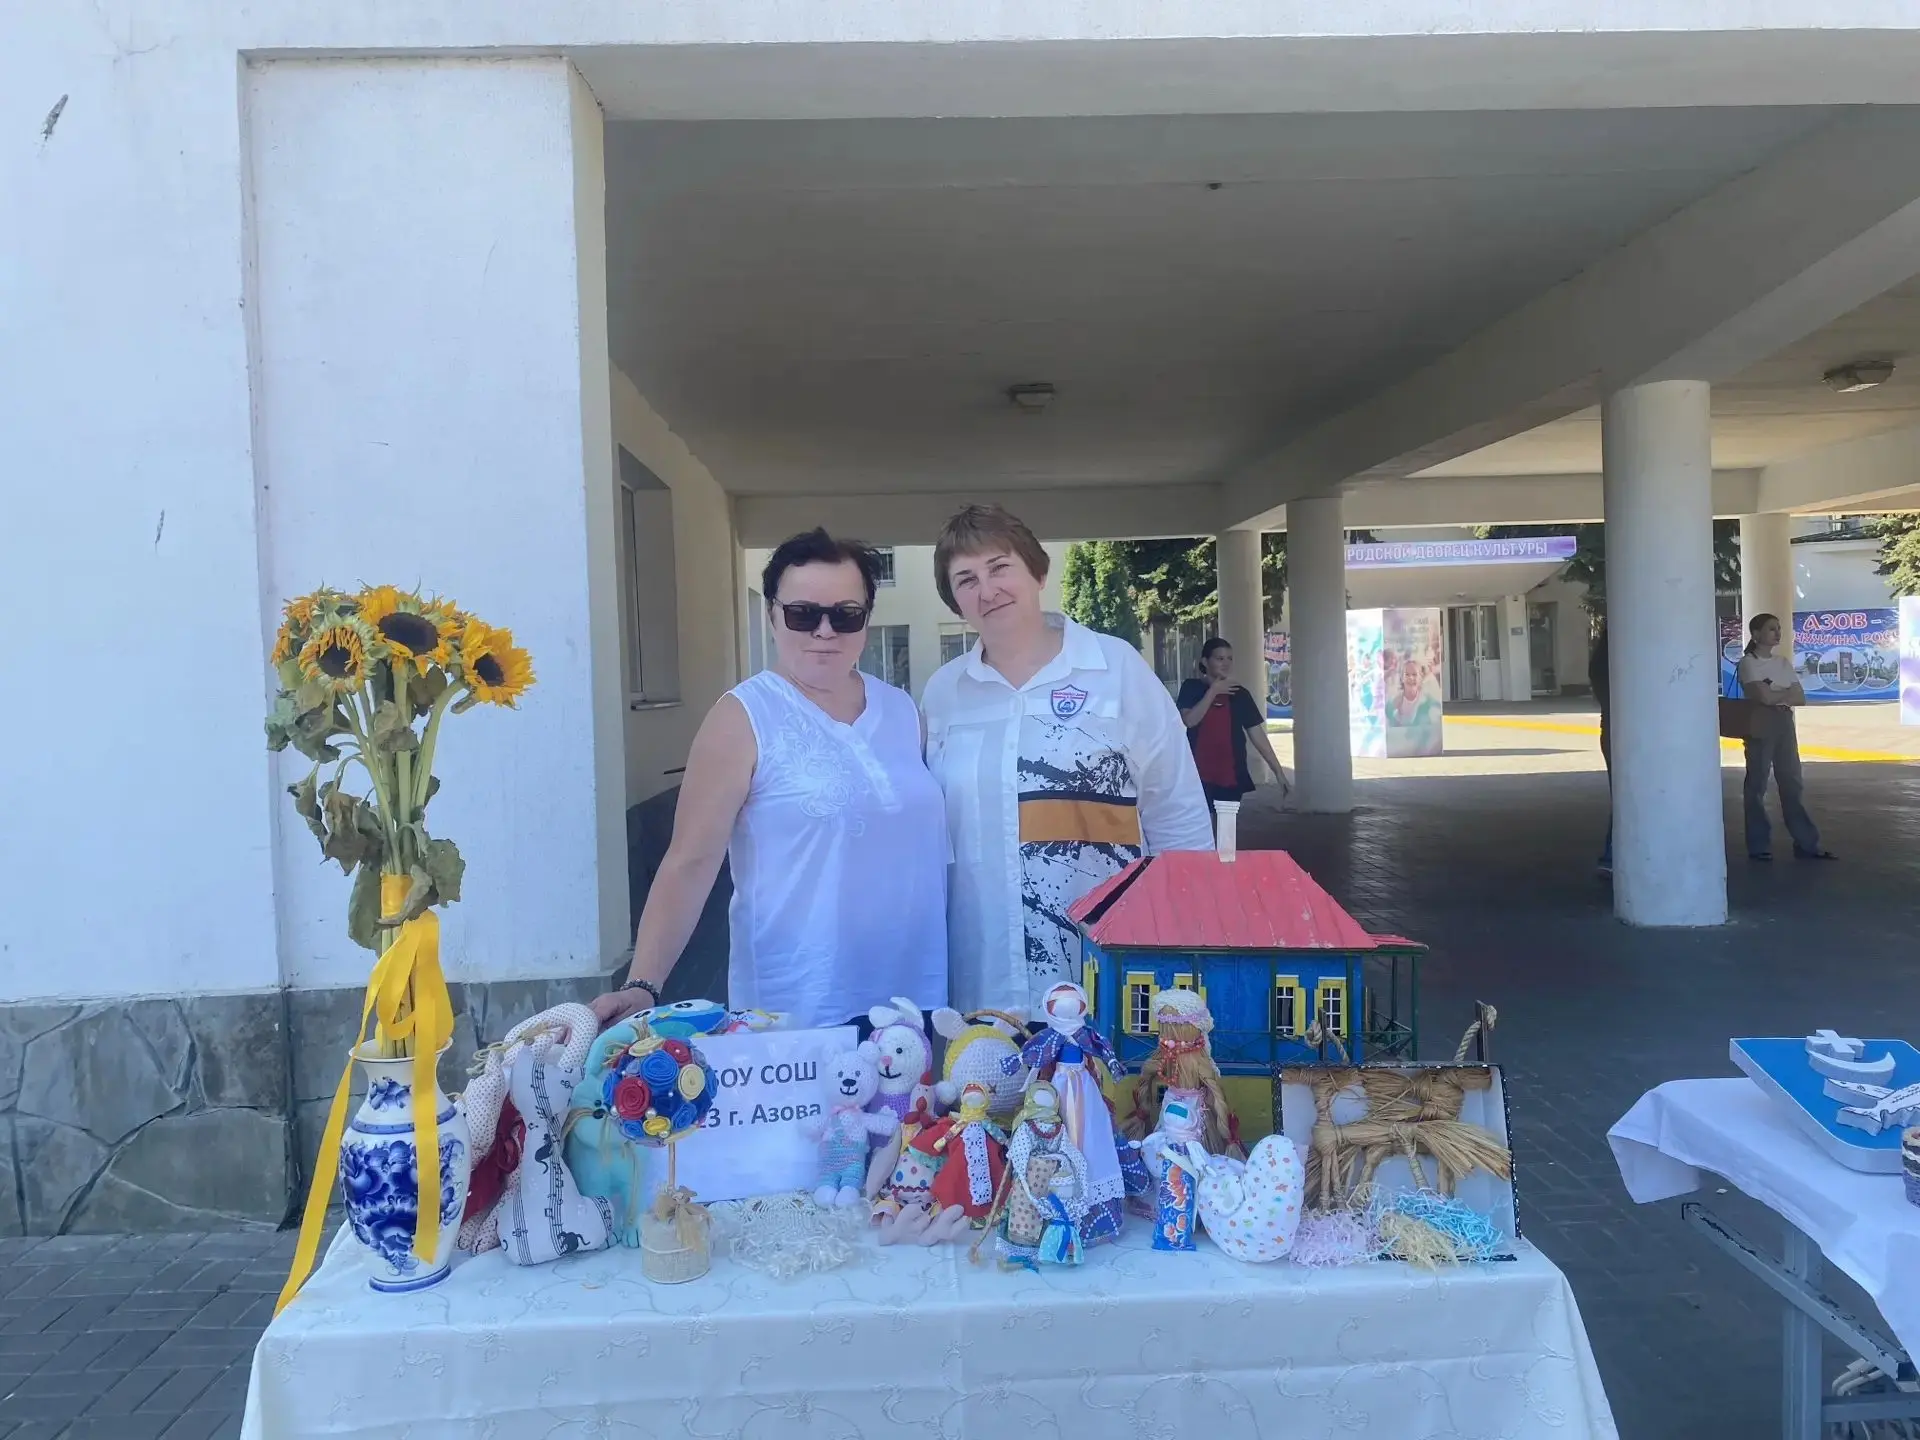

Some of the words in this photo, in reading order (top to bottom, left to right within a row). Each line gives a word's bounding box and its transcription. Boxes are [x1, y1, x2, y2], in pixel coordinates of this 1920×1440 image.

[1346, 545, 1412, 562] РОДСКОЙ
[1415, 543, 1470, 560] ДВОРЕЦ
[1473, 541, 1548, 556] КУЛЬТУРЫ
[1803, 612, 1868, 632] АЗОВ
[760, 1061, 817, 1085] СОШ
[729, 1110, 744, 1126] г.
[751, 1103, 821, 1125] Азова
